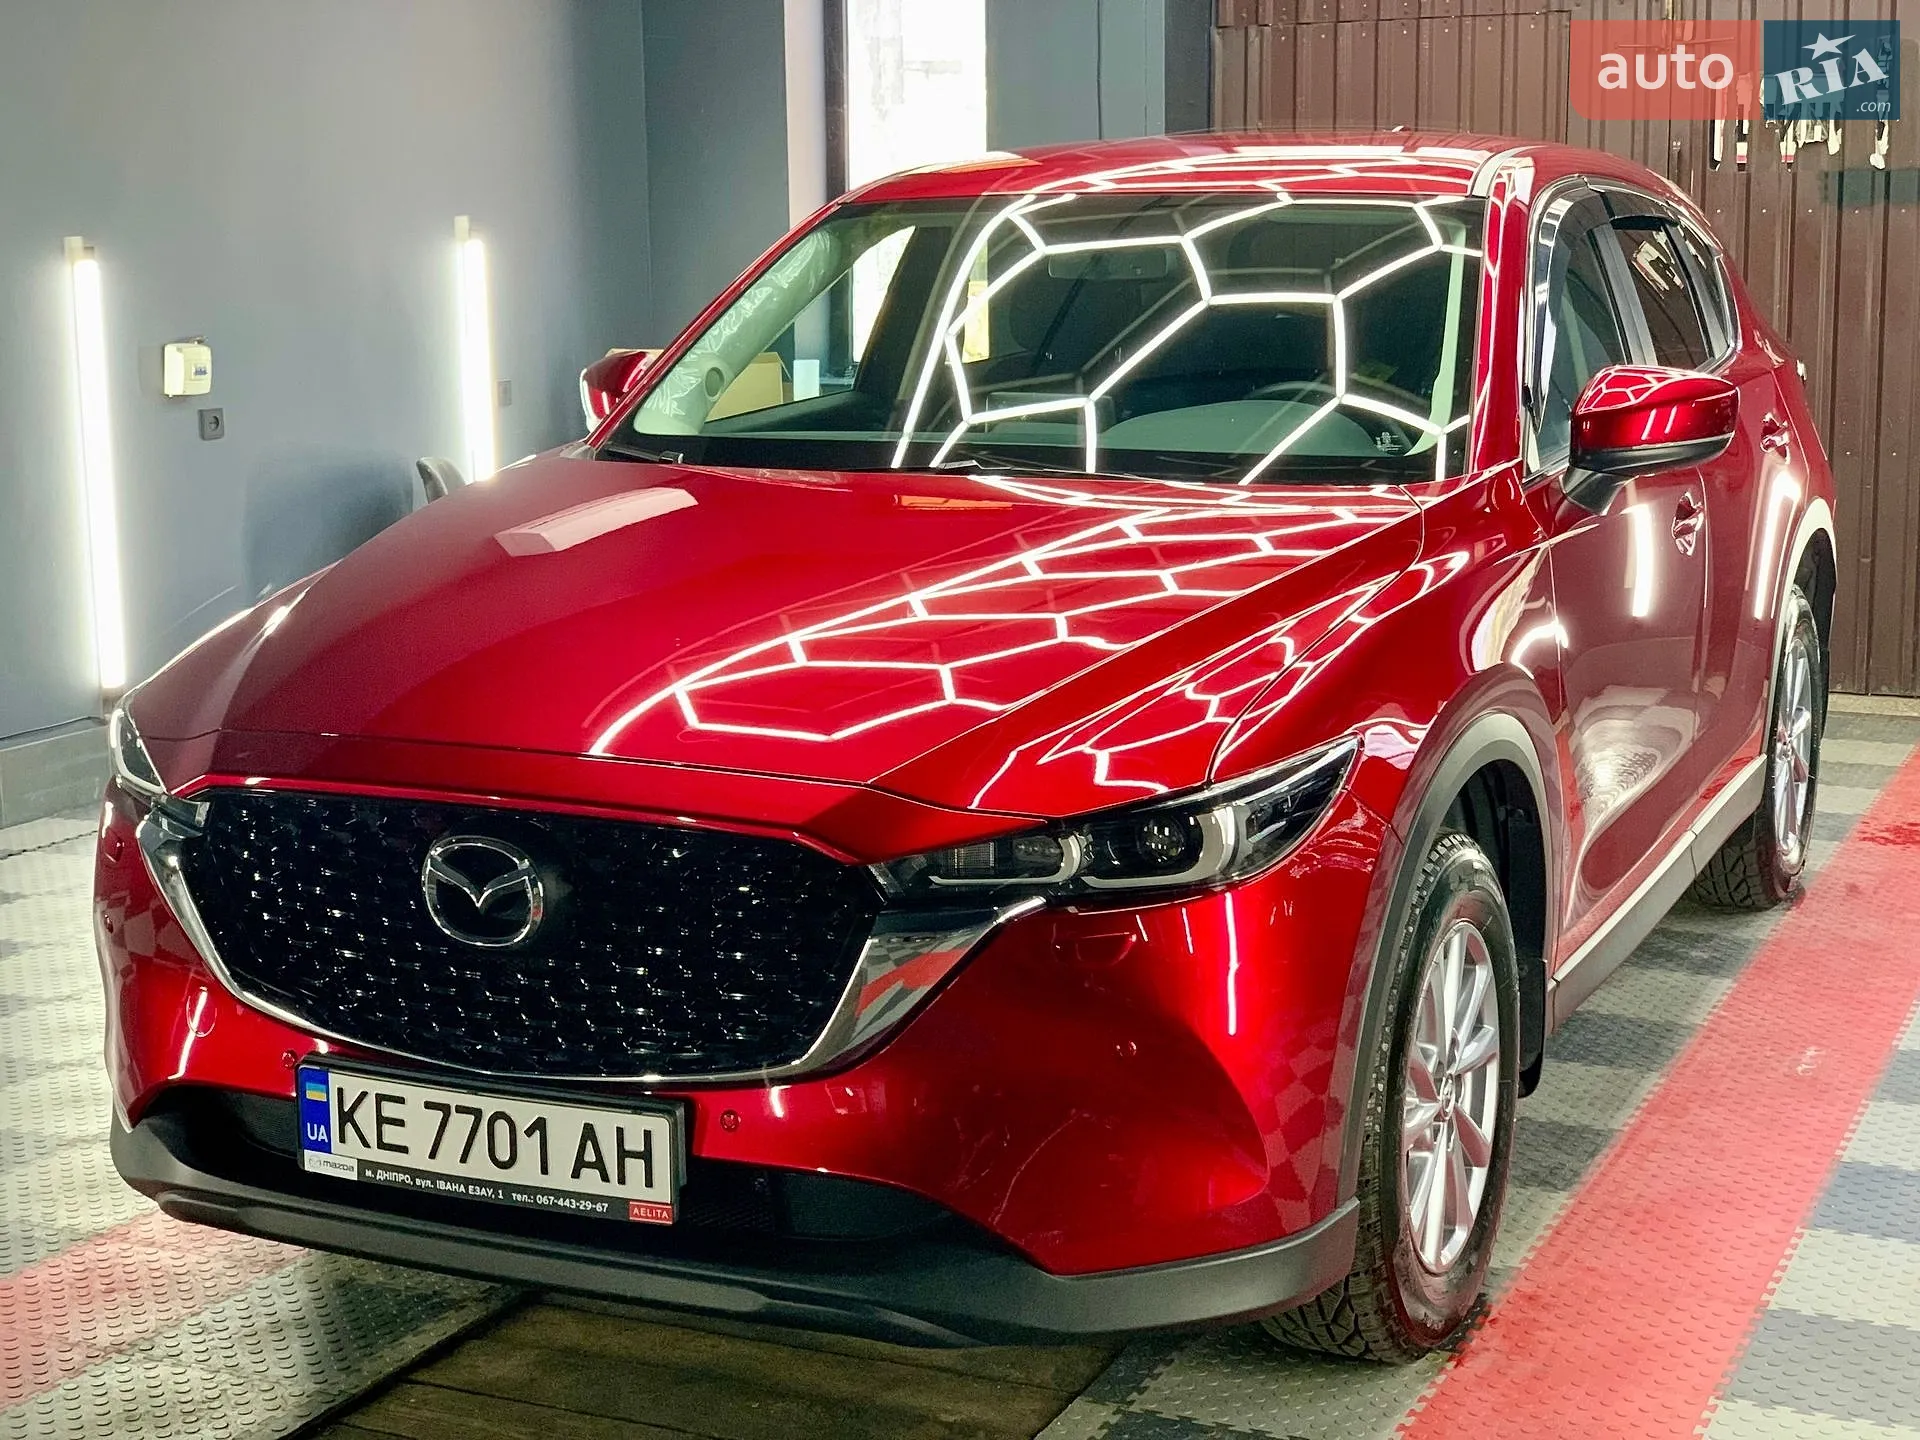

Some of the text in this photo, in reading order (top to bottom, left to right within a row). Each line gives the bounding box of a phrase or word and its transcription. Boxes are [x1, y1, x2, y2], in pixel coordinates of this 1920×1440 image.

[306, 1123, 328, 1143] UA
[336, 1087, 654, 1188] KE 7701 AH
[323, 1159, 355, 1172] mazda
[376, 1169, 413, 1185] ДНІПРО,
[415, 1177, 434, 1189] вул.
[436, 1180, 466, 1194] ІВАНА
[498, 1189, 504, 1200] 1
[512, 1192, 534, 1203] тел.:
[536, 1194, 609, 1213] 067-443-29-67
[632, 1207, 669, 1219] AELITA
